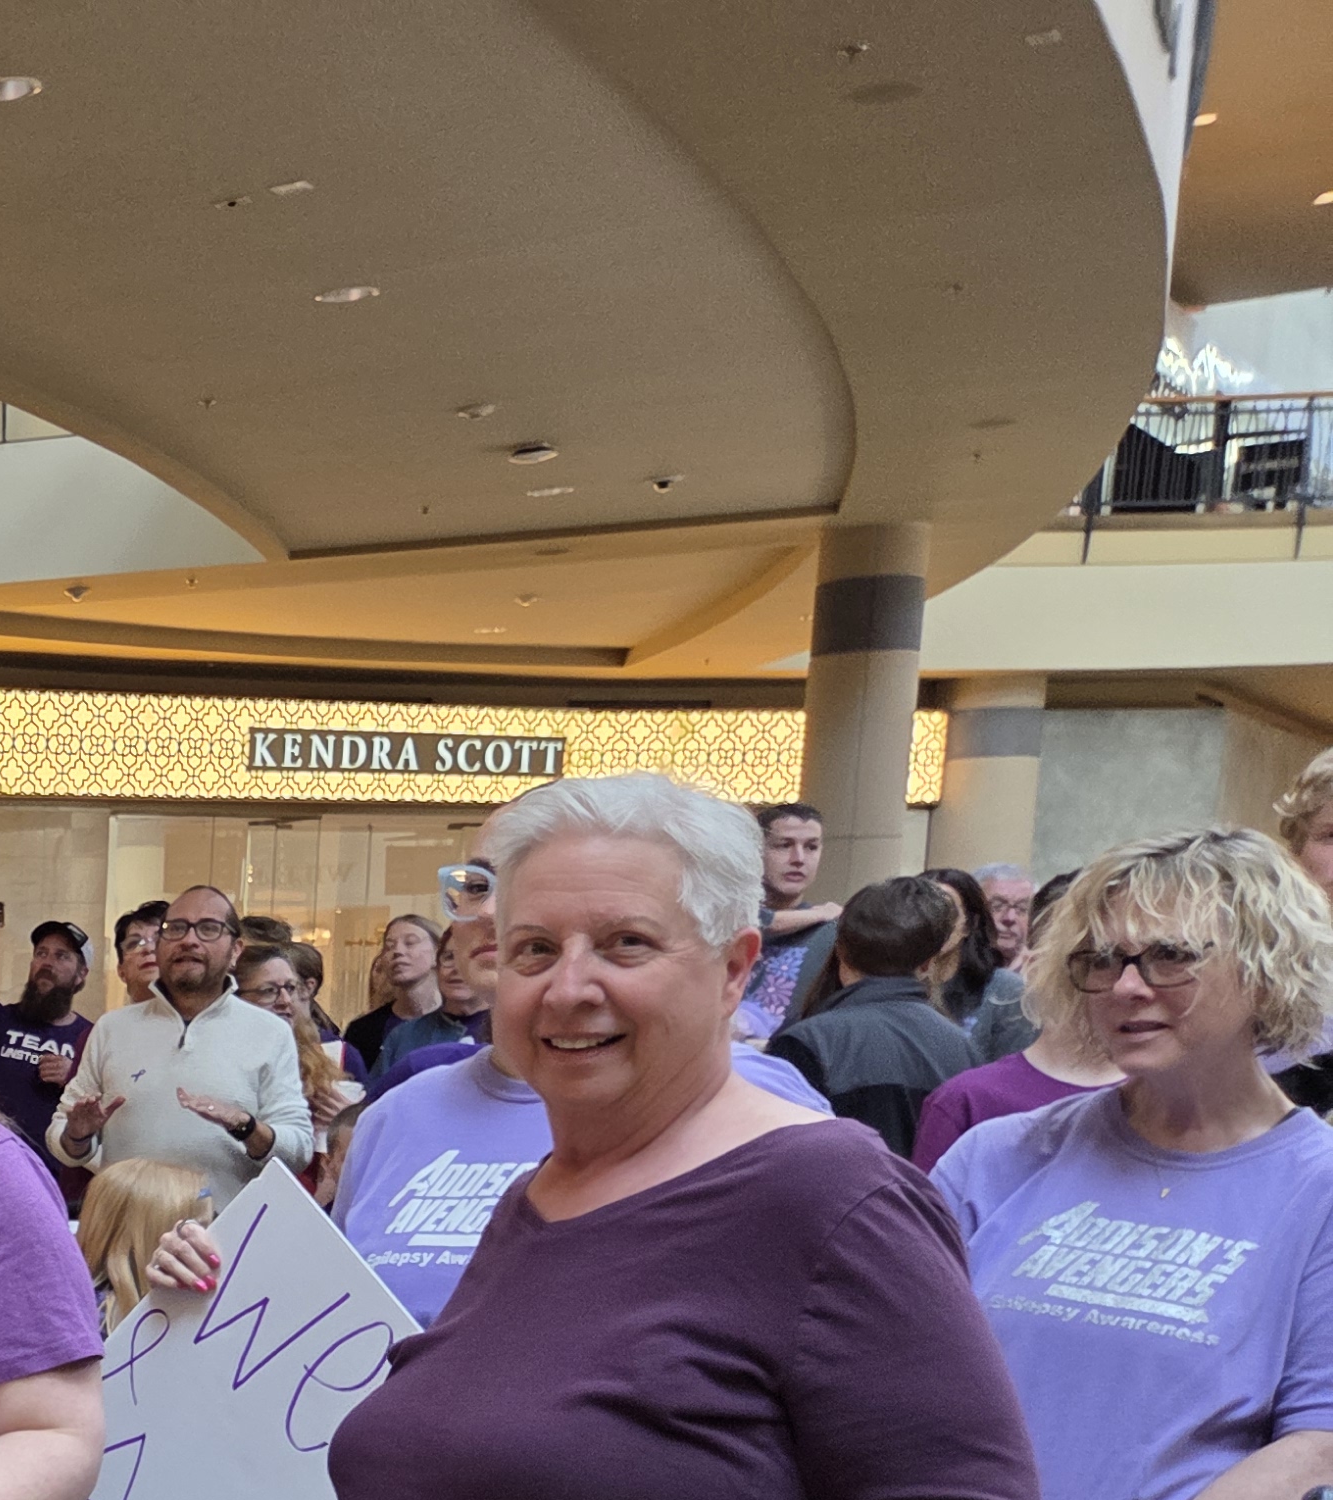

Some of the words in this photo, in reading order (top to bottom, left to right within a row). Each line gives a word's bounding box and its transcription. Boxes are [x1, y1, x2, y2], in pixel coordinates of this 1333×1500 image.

[252, 732, 420, 771] KENDRA
[435, 737, 563, 775] SCOTT
[1018, 1200, 1260, 1275] ADDISON'S
[1012, 1244, 1229, 1306] AVENGERS
[194, 1203, 393, 1452] We
[1084, 1308, 1220, 1346] Awareness
